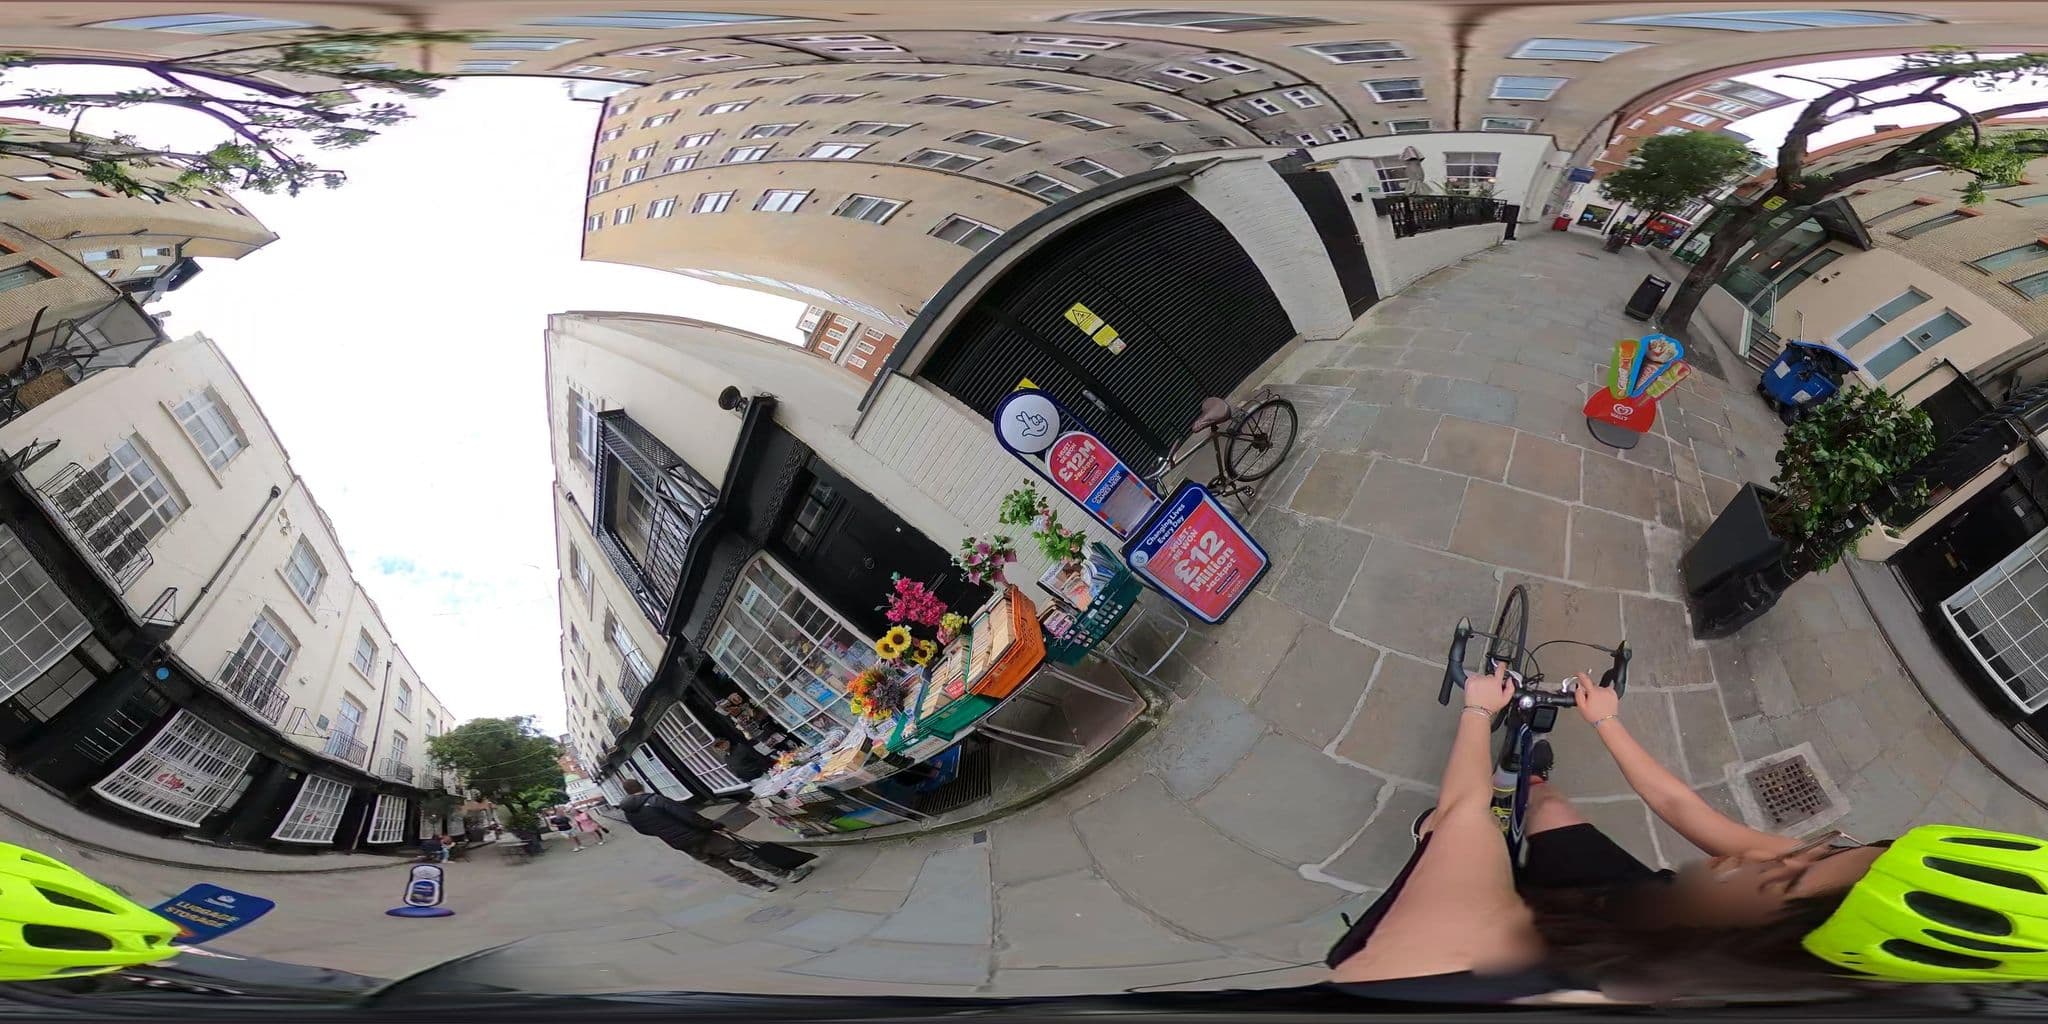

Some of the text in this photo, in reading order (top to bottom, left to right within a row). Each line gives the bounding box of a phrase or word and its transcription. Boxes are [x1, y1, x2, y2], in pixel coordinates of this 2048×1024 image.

[1058, 440, 1095, 482] £12M
[1073, 455, 1096, 481] Jackpot
[1146, 504, 1185, 546] Changing Lives
[1157, 515, 1185, 544] Every Day
[1170, 529, 1189, 551] MUST
[1180, 529, 1198, 551] WON
[1174, 530, 1225, 585] £12
[1190, 547, 1234, 592] Million
[1205, 558, 1236, 592] Jackpot
